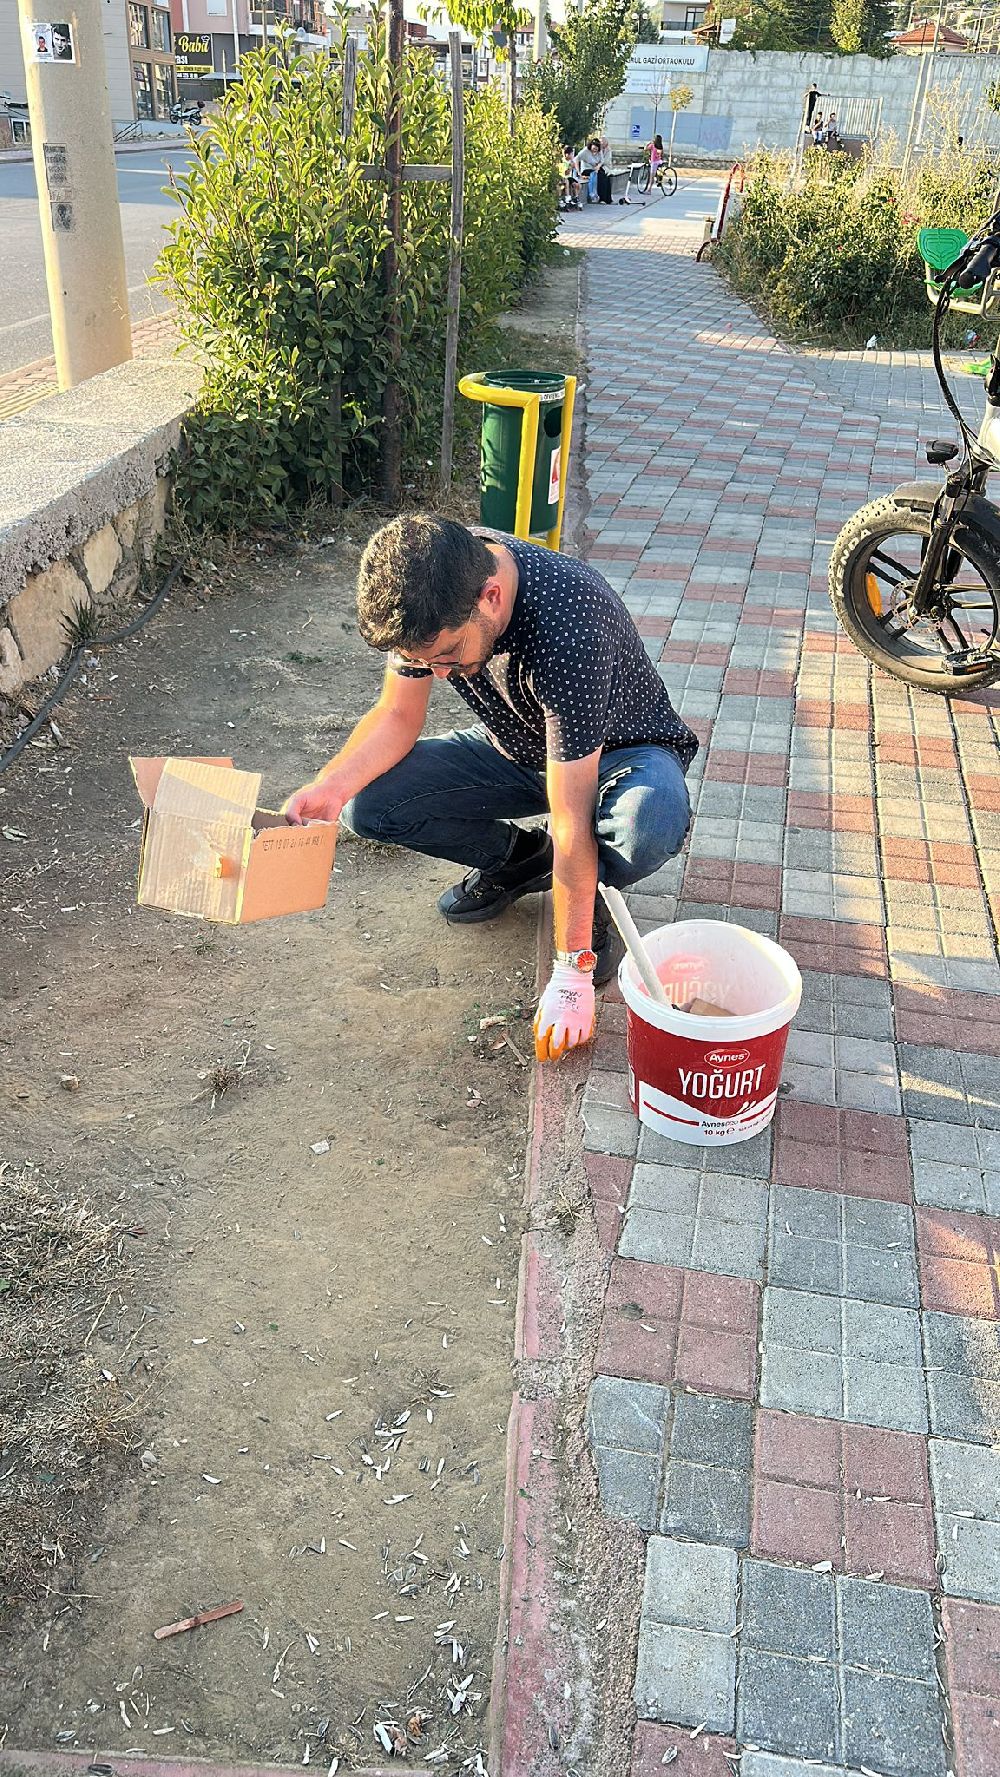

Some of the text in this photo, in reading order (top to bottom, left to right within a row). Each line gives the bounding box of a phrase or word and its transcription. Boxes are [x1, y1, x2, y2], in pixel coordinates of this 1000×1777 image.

[643, 55, 657, 64] GAZİ
[657, 57, 695, 66] ORTAOKULU
[835, 528, 872, 598] KENDA
[709, 1053, 745, 1063] Aynes
[678, 1063, 766, 1099] YOĞURT
[715, 1129, 725, 1137] kg
